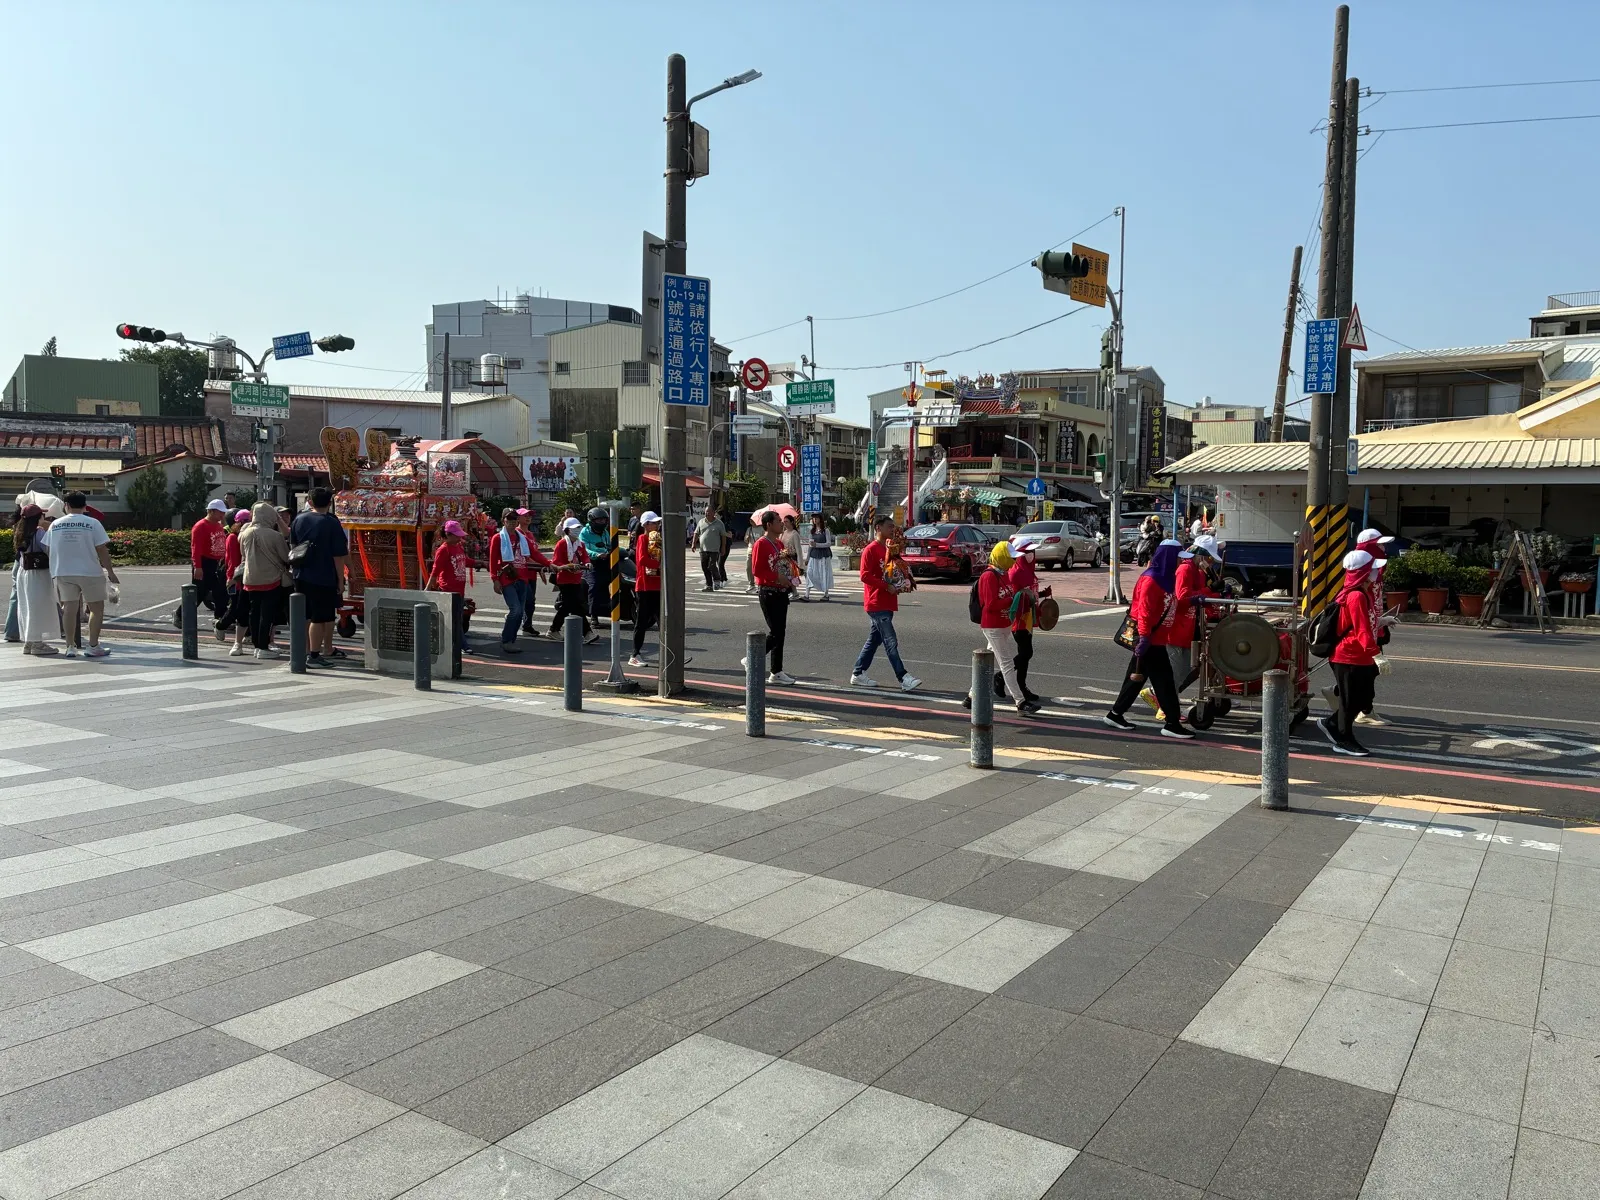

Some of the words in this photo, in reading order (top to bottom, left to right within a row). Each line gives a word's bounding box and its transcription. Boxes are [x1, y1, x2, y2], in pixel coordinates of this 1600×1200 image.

[666, 289, 706, 302] 10-19時
[667, 278, 707, 292] 例假日
[667, 301, 684, 400] 號誌通過路口
[688, 303, 705, 403] 請依行人專用
[1307, 334, 1320, 391] 號誌通過路口
[1321, 333, 1335, 391] 請依行人專用
[1350, 442, 1357, 459] P
